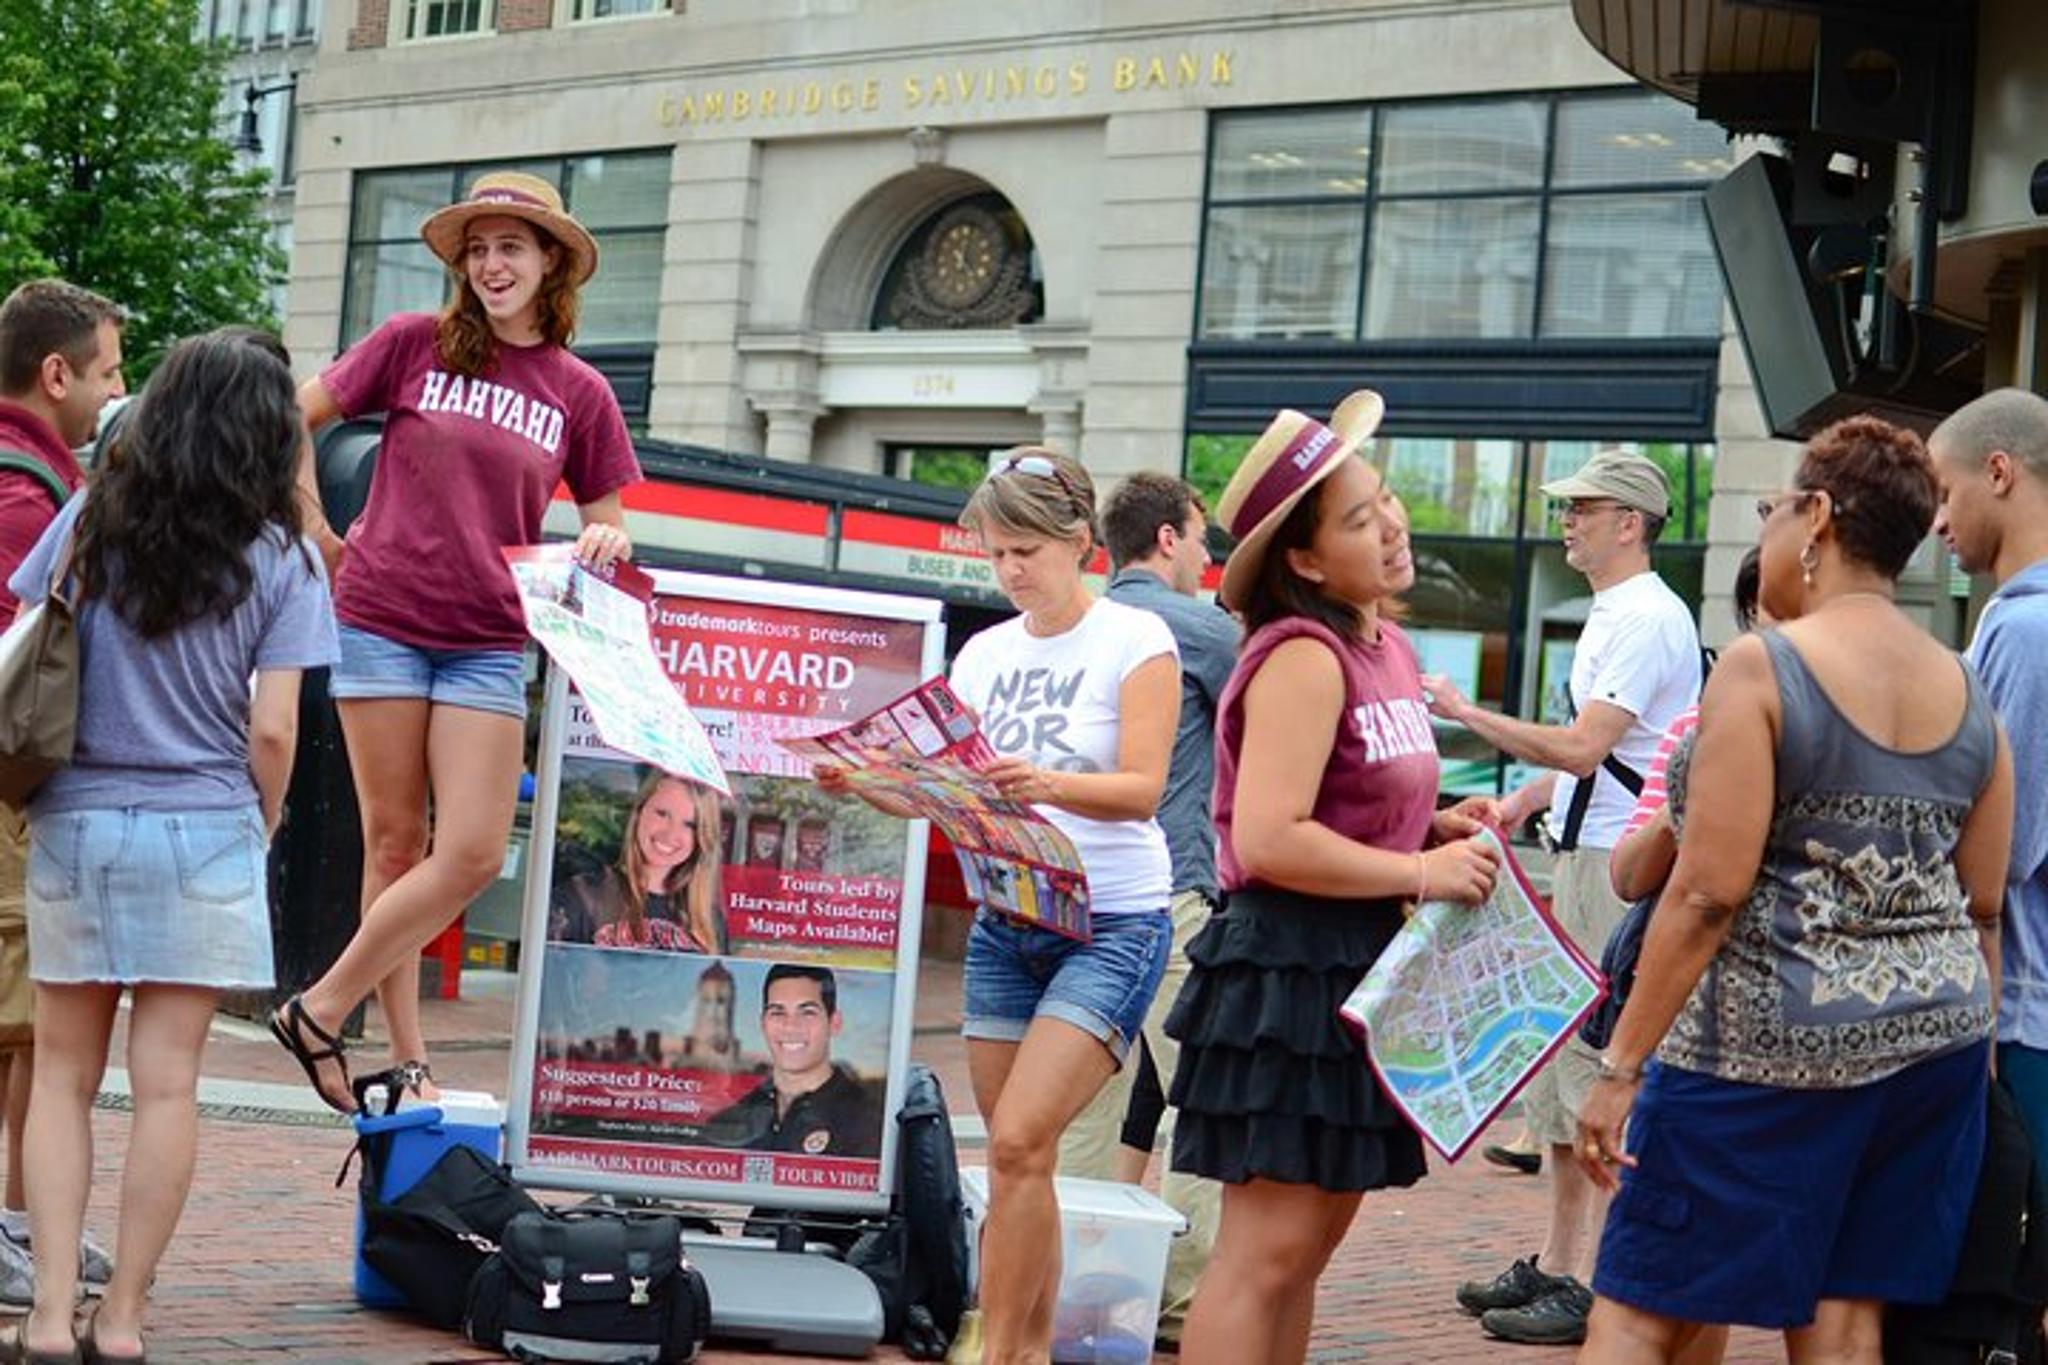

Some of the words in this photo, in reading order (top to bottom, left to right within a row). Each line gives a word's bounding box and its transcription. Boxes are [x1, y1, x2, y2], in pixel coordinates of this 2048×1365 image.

[658, 79, 879, 127] CAMBRIDGE
[903, 60, 1089, 108] SAVINGS
[1112, 50, 1232, 92] BANK
[418, 370, 566, 453] HAHVAHD
[907, 553, 955, 579] BUSES
[809, 624, 888, 650] presents
[654, 637, 855, 690] HARVARD
[671, 682, 853, 714] NIVERSITY
[986, 666, 1086, 713] NEW
[780, 875, 834, 895] Tours
[840, 879, 869, 898] led
[874, 882, 899, 902] by
[730, 892, 807, 915] Harvard
[813, 900, 897, 923] Students
[746, 917, 796, 938] Maps
[801, 921, 896, 945] Available!
[542, 1064, 641, 1087] Suggested
[565, 1093, 612, 1107] person
[779, 1166, 823, 1184] TOUR
